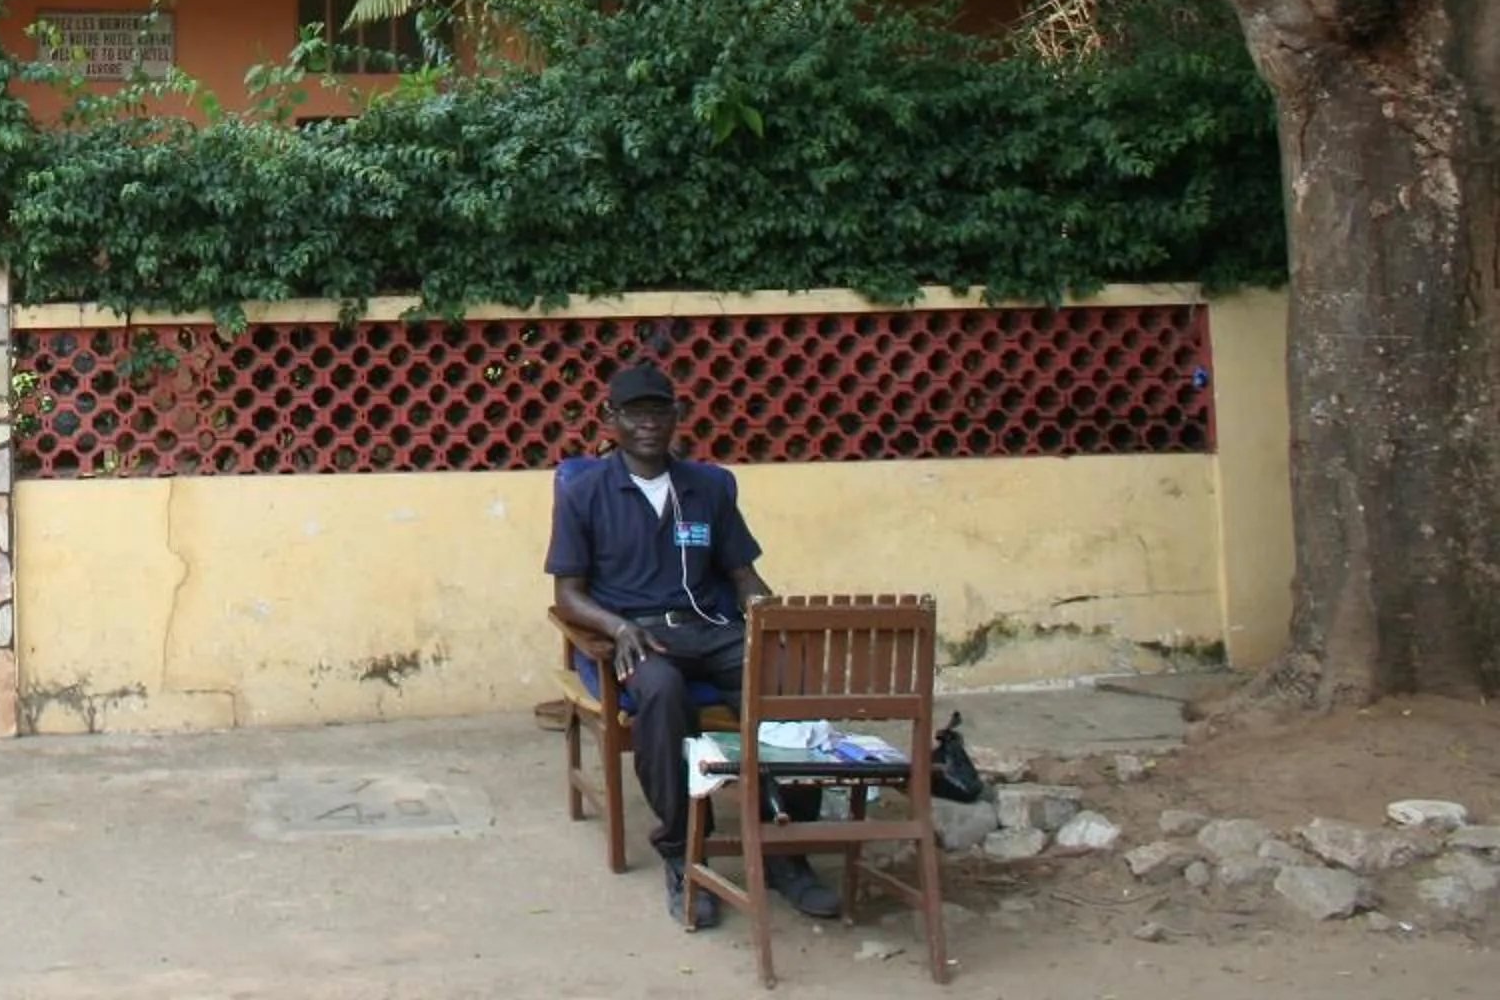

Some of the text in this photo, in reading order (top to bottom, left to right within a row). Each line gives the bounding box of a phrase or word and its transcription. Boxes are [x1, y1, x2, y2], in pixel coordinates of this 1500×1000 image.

[103, 32, 133, 46] HOTEL
[102, 47, 115, 61] TO
[86, 62, 123, 75] AURORE
